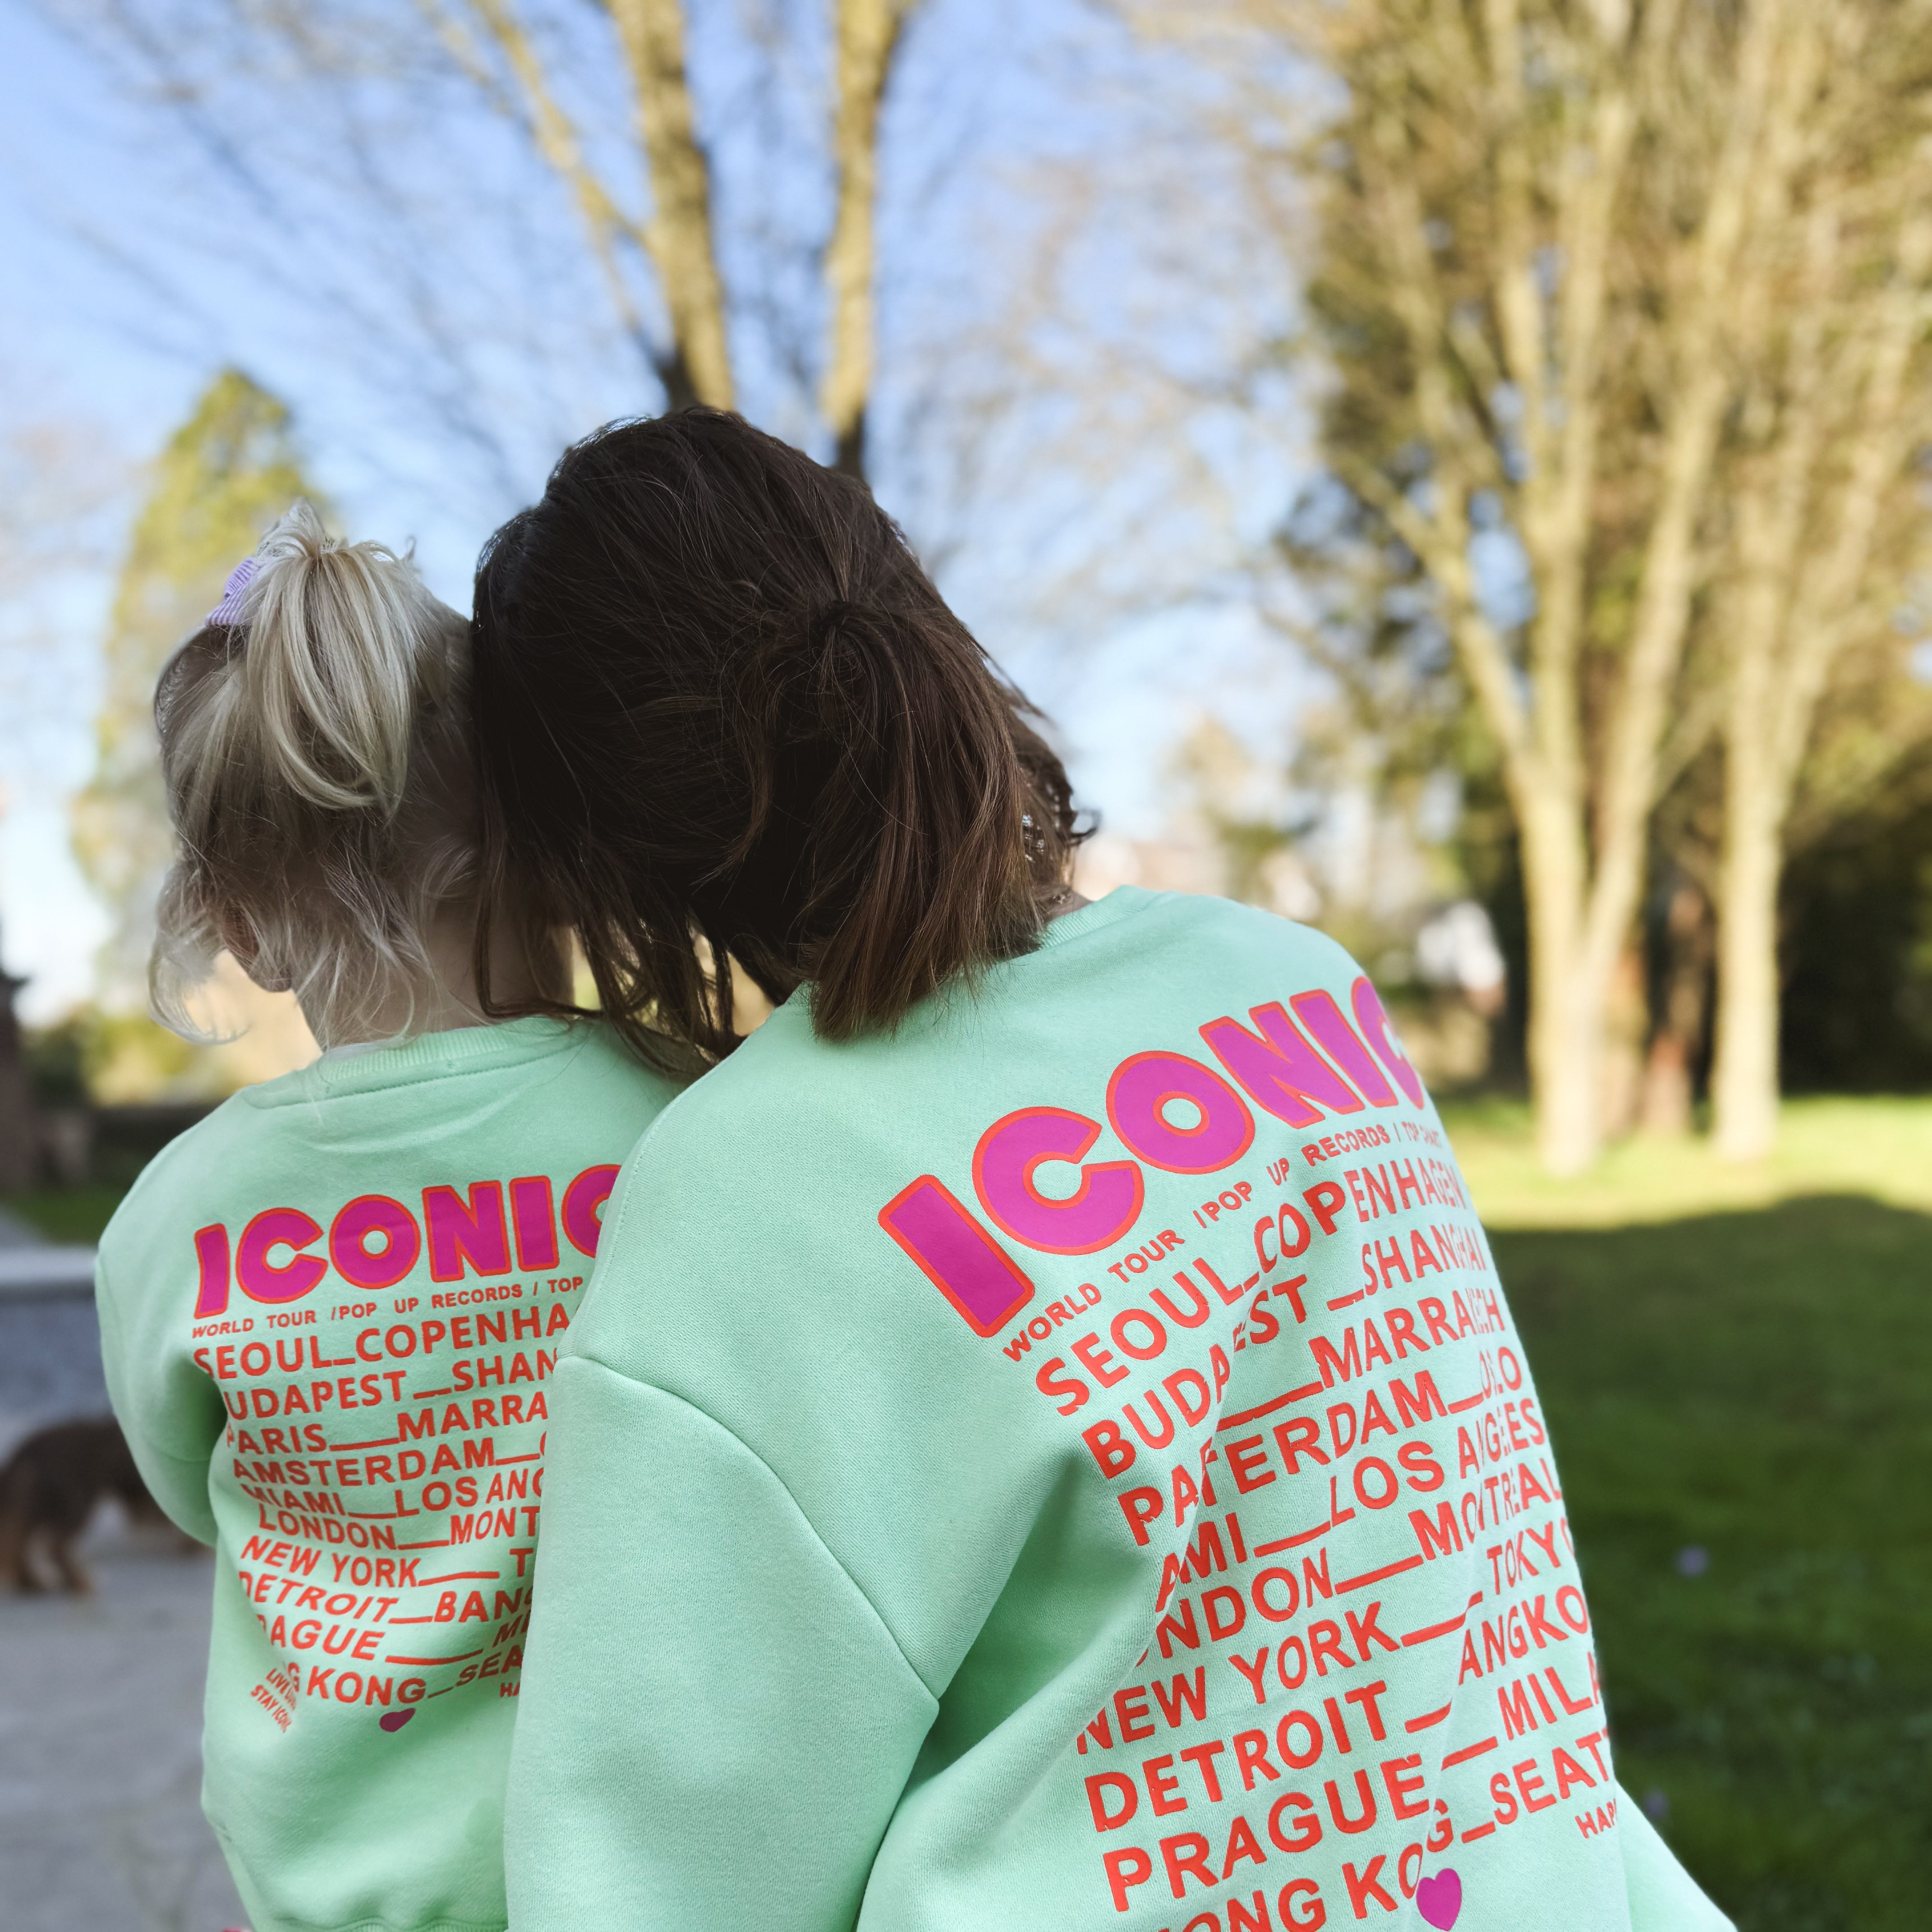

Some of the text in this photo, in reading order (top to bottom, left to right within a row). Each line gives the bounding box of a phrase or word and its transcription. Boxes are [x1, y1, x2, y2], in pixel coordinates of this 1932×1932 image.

[878, 975, 1424, 1339] ICONIC
[193, 1164, 622, 1320] ICONIC
[1003, 1283, 1102, 1362] WORLD
[1108, 1229, 1185, 1283] TOUR
[1266, 1158, 1289, 1186] UP
[1302, 1124, 1391, 1167] RECORDS
[192, 1318, 254, 1339] WORLD
[267, 1310, 316, 1328] TOUR
[394, 1297, 419, 1314] UP
[431, 1284, 522, 1308] RECORDS
[547, 1276, 583, 1293] TOP
[355, 1302, 579, 1362] COPENHA
[1035, 1257, 1244, 1417] SEOUL
[233, 1438, 496, 1488] AMSTERDAM
[395, 1476, 478, 1518] LOS
[1330, 1441, 1445, 1528] LOS
[240, 1535, 322, 1577] NEW
[332, 1553, 421, 1588] YORK
[259, 1504, 396, 1550] LONDON
[257, 1615, 385, 1661] AGUE
[432, 1586, 534, 1624] BAN
[306, 1665, 427, 1706] KONG
[1076, 1665, 1207, 1755] NEW
[1228, 1601, 1400, 1705] YORK
[1084, 1680, 1387, 1833] DETROIT
[1490, 1726, 1609, 1825] SEAT
[1102, 1753, 1430, 1913] PRAGUE
